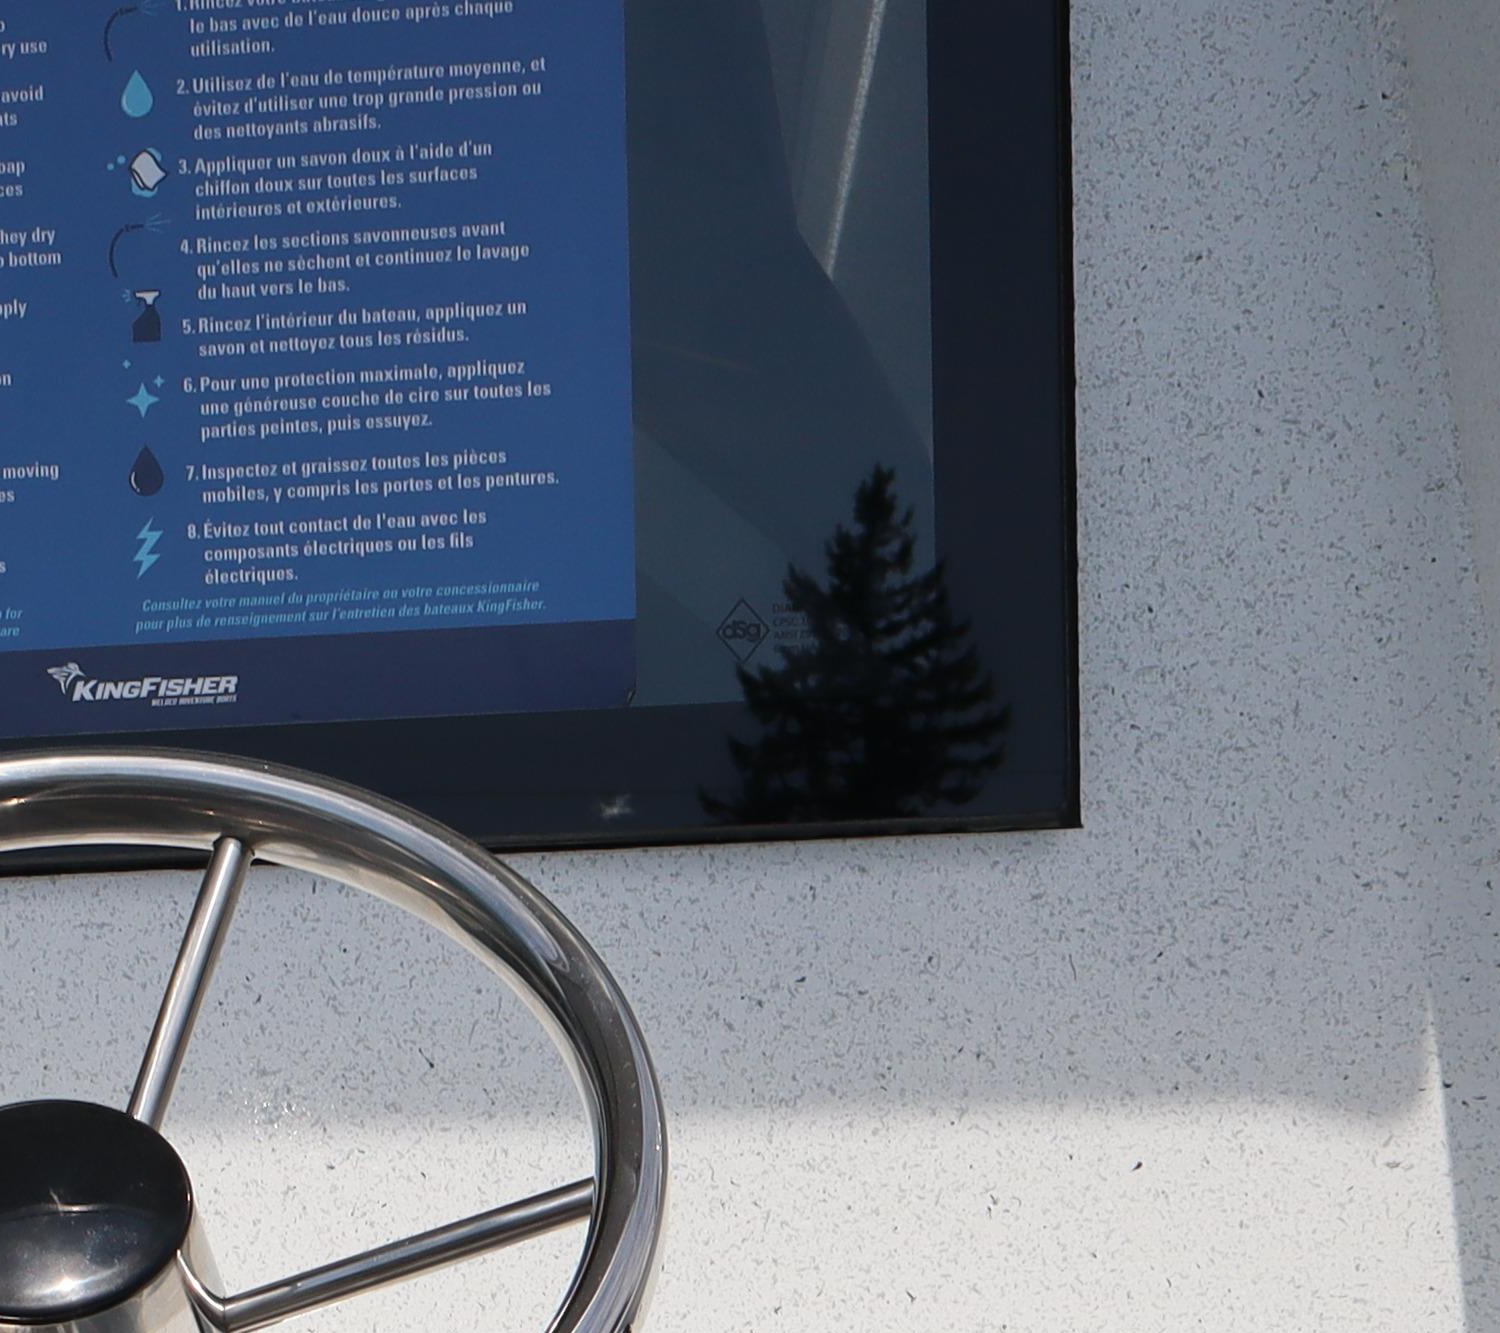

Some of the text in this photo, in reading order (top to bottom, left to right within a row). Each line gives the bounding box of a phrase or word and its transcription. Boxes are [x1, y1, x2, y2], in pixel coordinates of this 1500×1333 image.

[189, 0, 513, 34] le bas avec de l'eau douce après chaque
[19, 40, 47, 54] use
[190, 37, 275, 57] utilisation.
[192, 81, 541, 116] évitez d'utiliser une trop grande pression ou
[193, 112, 382, 140] des nettoyants abrasifs.
[194, 165, 477, 197] chiffon doux sur toutes les surfaces
[30, 225, 55, 245] dry
[8, 250, 61, 267] bottom
[196, 243, 529, 281] qu'elles ne sèchent et continuez le lavage
[197, 276, 351, 300] du haut vers le bas.
[198, 325, 470, 357] savon et nettoyez tous les résidus.
[199, 379, 551, 417] une généreuse couche de cire sur toutes les
[200, 413, 433, 443] parties peintes, puis essuyez.
[203, 530, 473, 564] composants électriques ou les fils
[141, 596, 202, 612] Consultez
[204, 596, 236, 609] votre
[237, 591, 285, 607] manuel
[286, 591, 303, 604] du
[381, 588, 398, 599] ou
[400, 585, 433, 598] votre
[434, 581, 540, 596] concessionnaire
[72, 676, 239, 702] KINGFISHER
